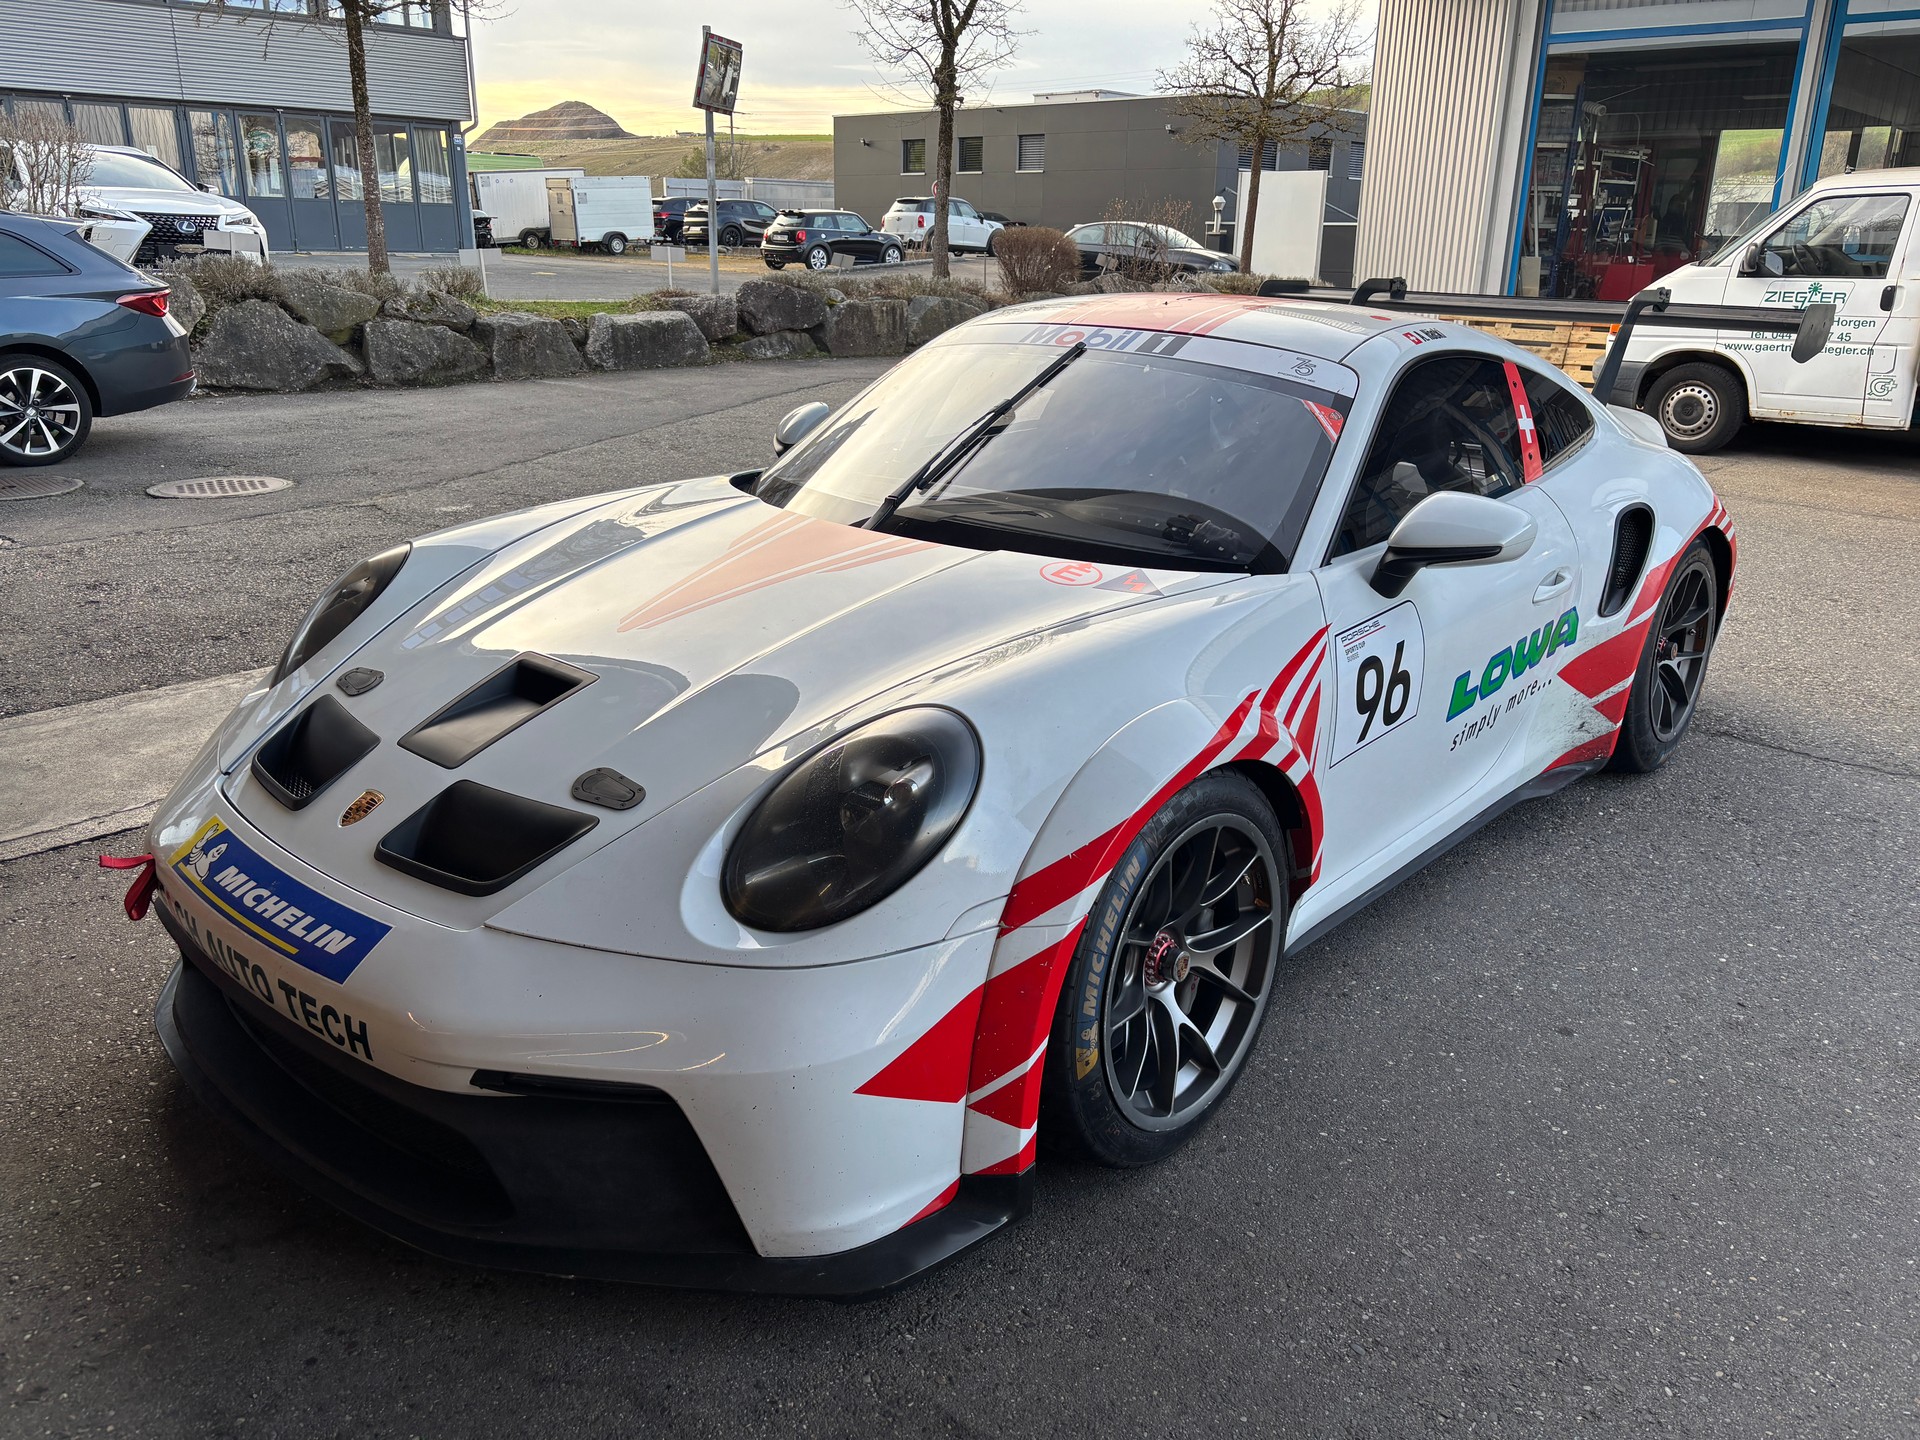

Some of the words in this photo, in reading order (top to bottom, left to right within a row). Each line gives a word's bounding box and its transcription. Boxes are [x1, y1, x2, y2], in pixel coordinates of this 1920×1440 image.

[1764, 289, 1847, 306] ZIEGLER
[1019, 325, 1143, 351] Mobil
[1837, 332, 1852, 342] 45
[1290, 356, 1317, 377] 75
[1341, 620, 1381, 644] PORSCHE
[1344, 643, 1359, 656] SPORTS
[1446, 606, 1579, 723] LOWA
[1356, 639, 1411, 745] 96
[1450, 704, 1502, 752] simply
[1505, 679, 1552, 714] more...
[213, 865, 357, 956] MICHELIN
[1082, 855, 1142, 1017] MICHELIN
[206, 928, 275, 1005] AUTO
[277, 977, 374, 1062] TECH
